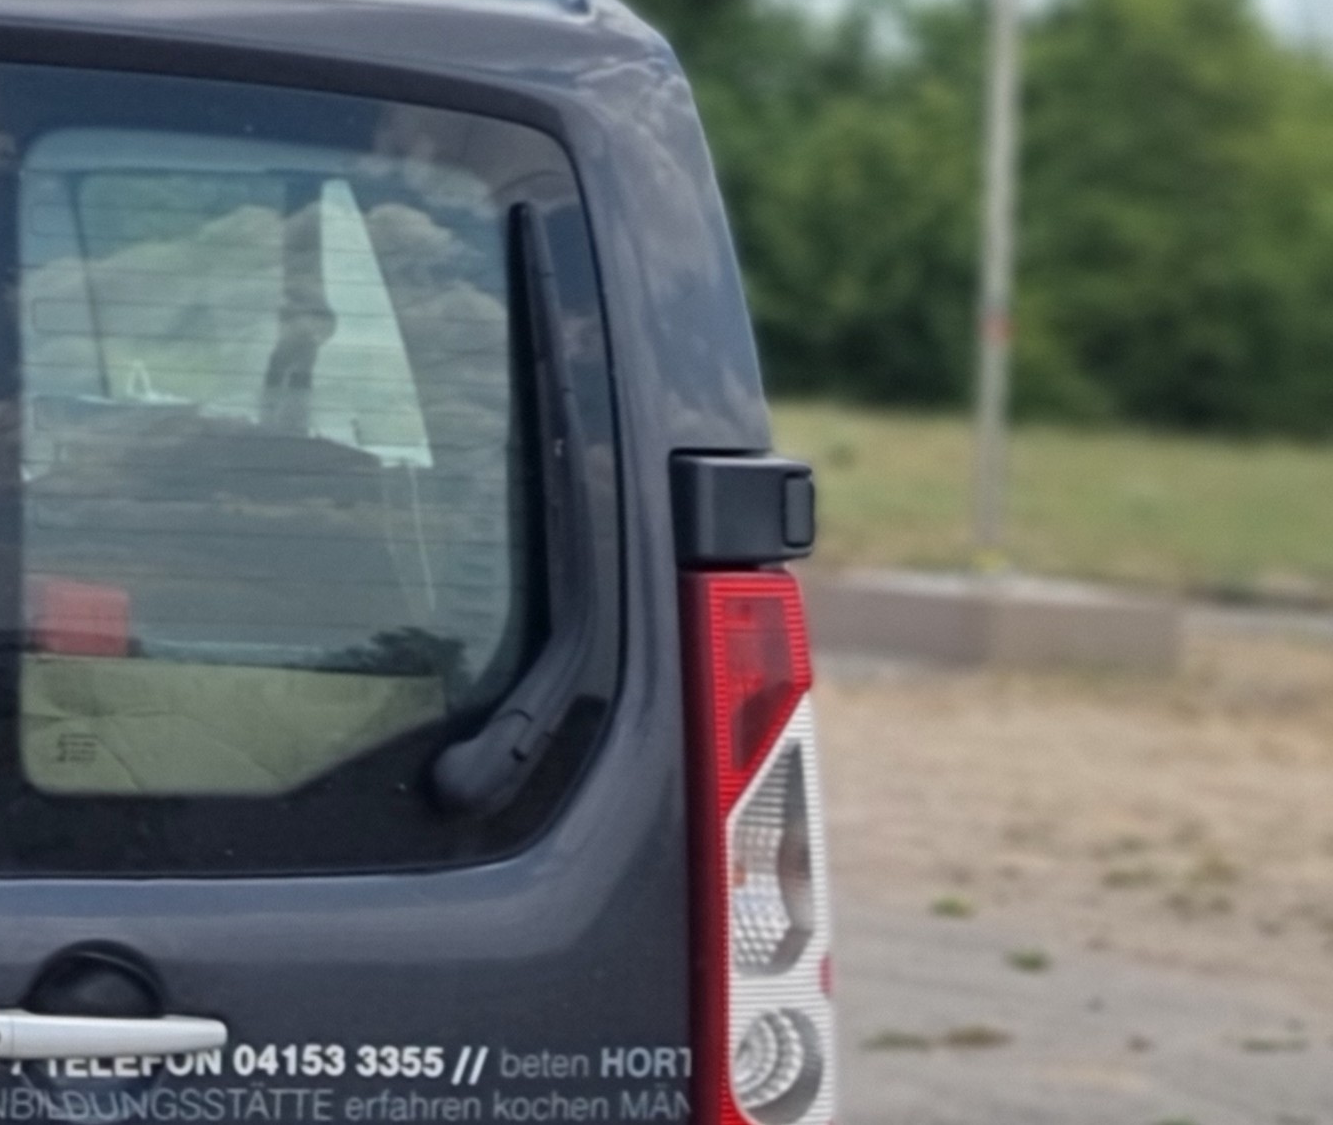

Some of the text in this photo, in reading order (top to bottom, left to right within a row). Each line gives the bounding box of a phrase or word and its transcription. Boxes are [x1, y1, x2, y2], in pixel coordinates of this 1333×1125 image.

[233, 1043, 346, 1076] 04153
[355, 1045, 444, 1078] 3355
[500, 1048, 590, 1078] beten
[344, 1087, 482, 1121] erfahren
[493, 1089, 609, 1121] kochen
